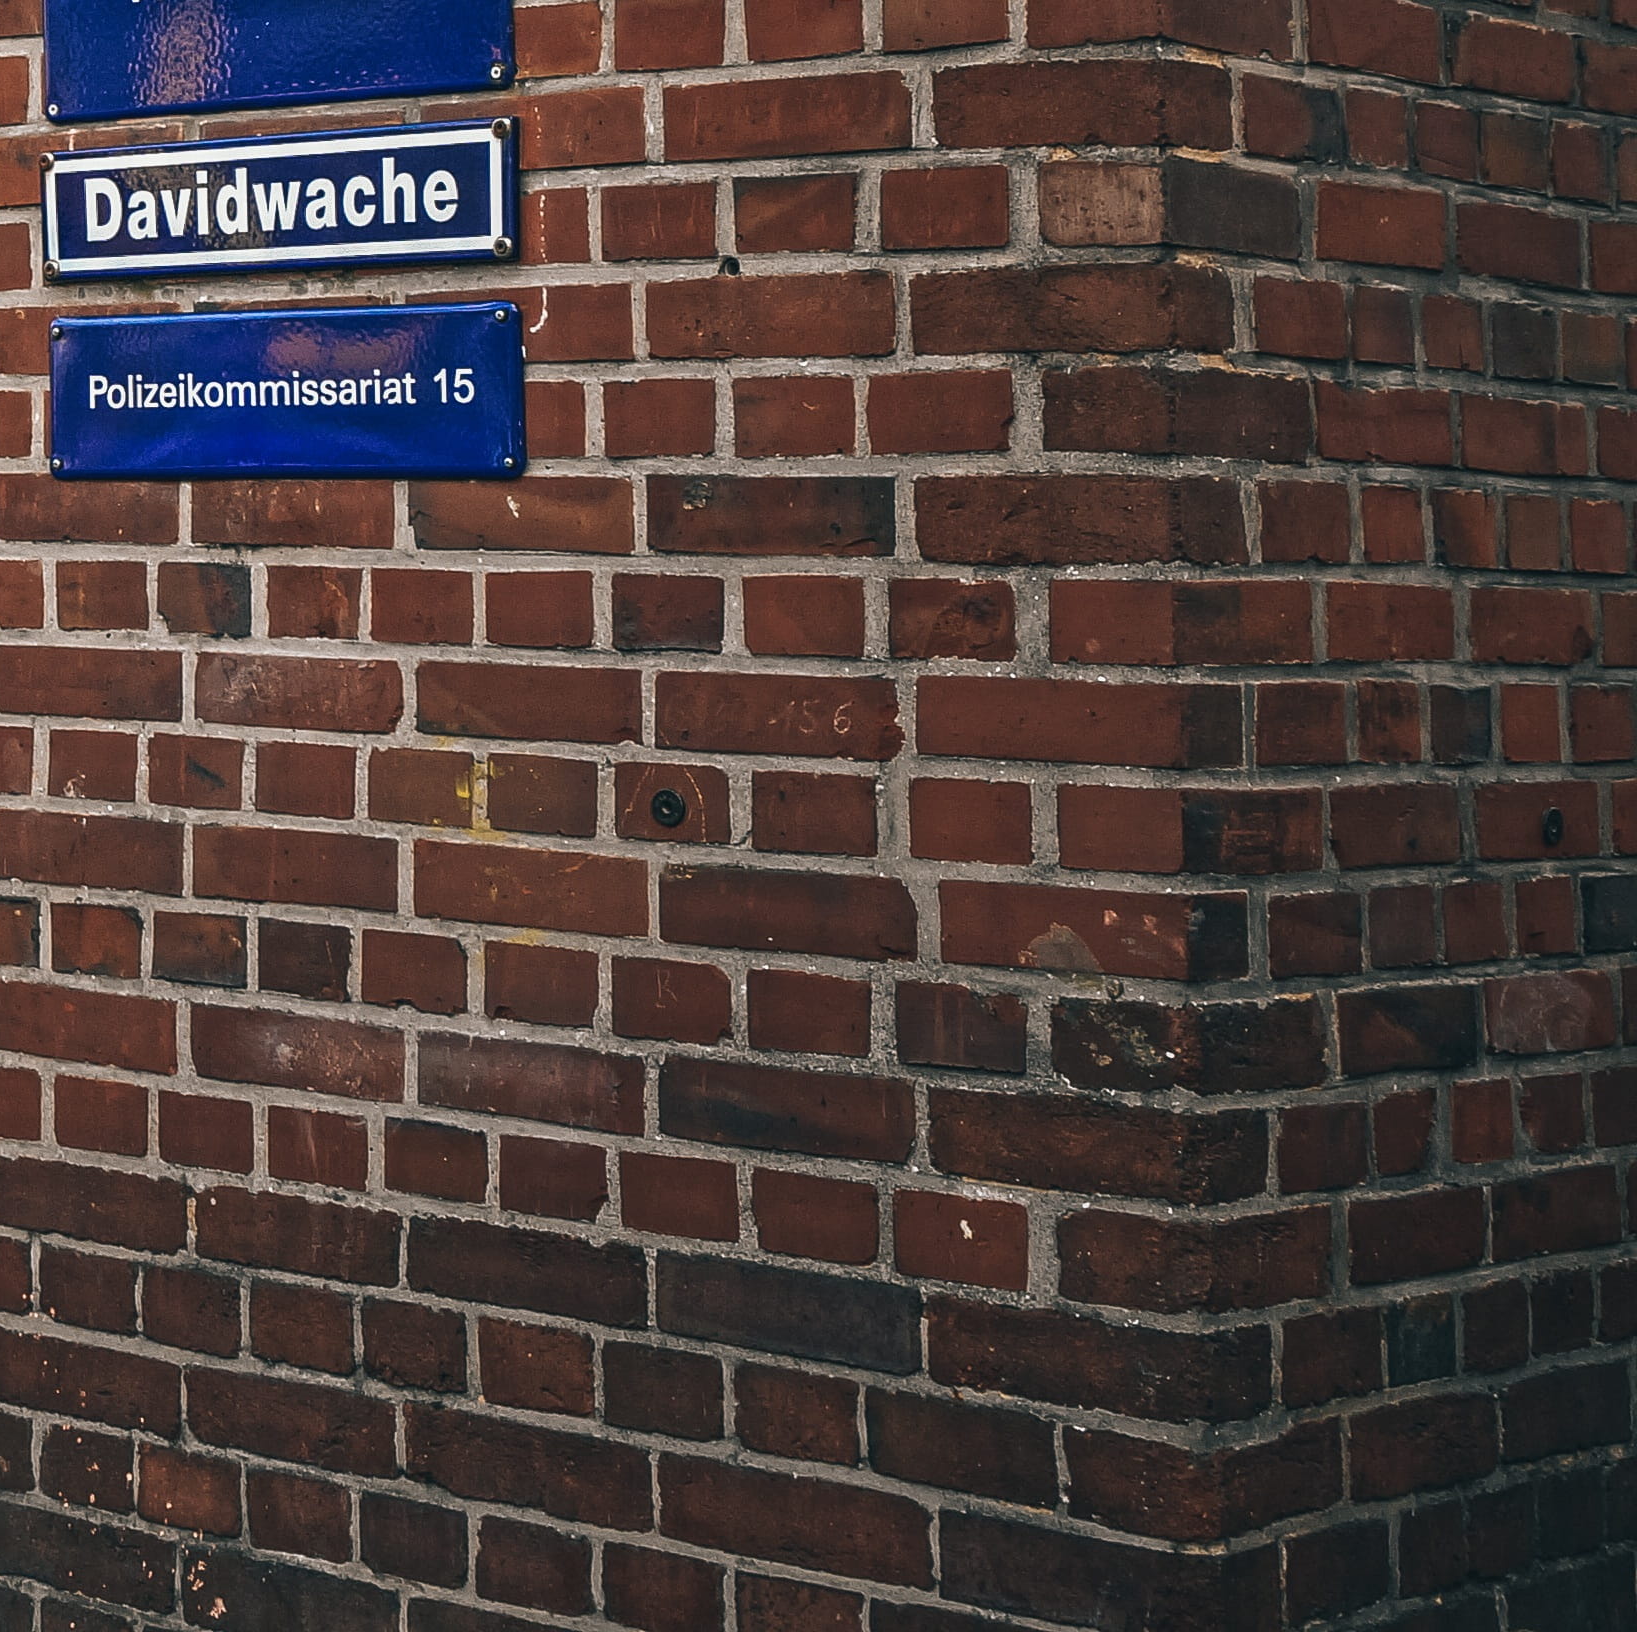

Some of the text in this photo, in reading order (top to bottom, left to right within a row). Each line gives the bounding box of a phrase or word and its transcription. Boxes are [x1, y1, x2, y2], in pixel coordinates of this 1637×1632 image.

[84, 156, 460, 243] Davidwache
[88, 368, 475, 410] Polizeikommissariat 15
